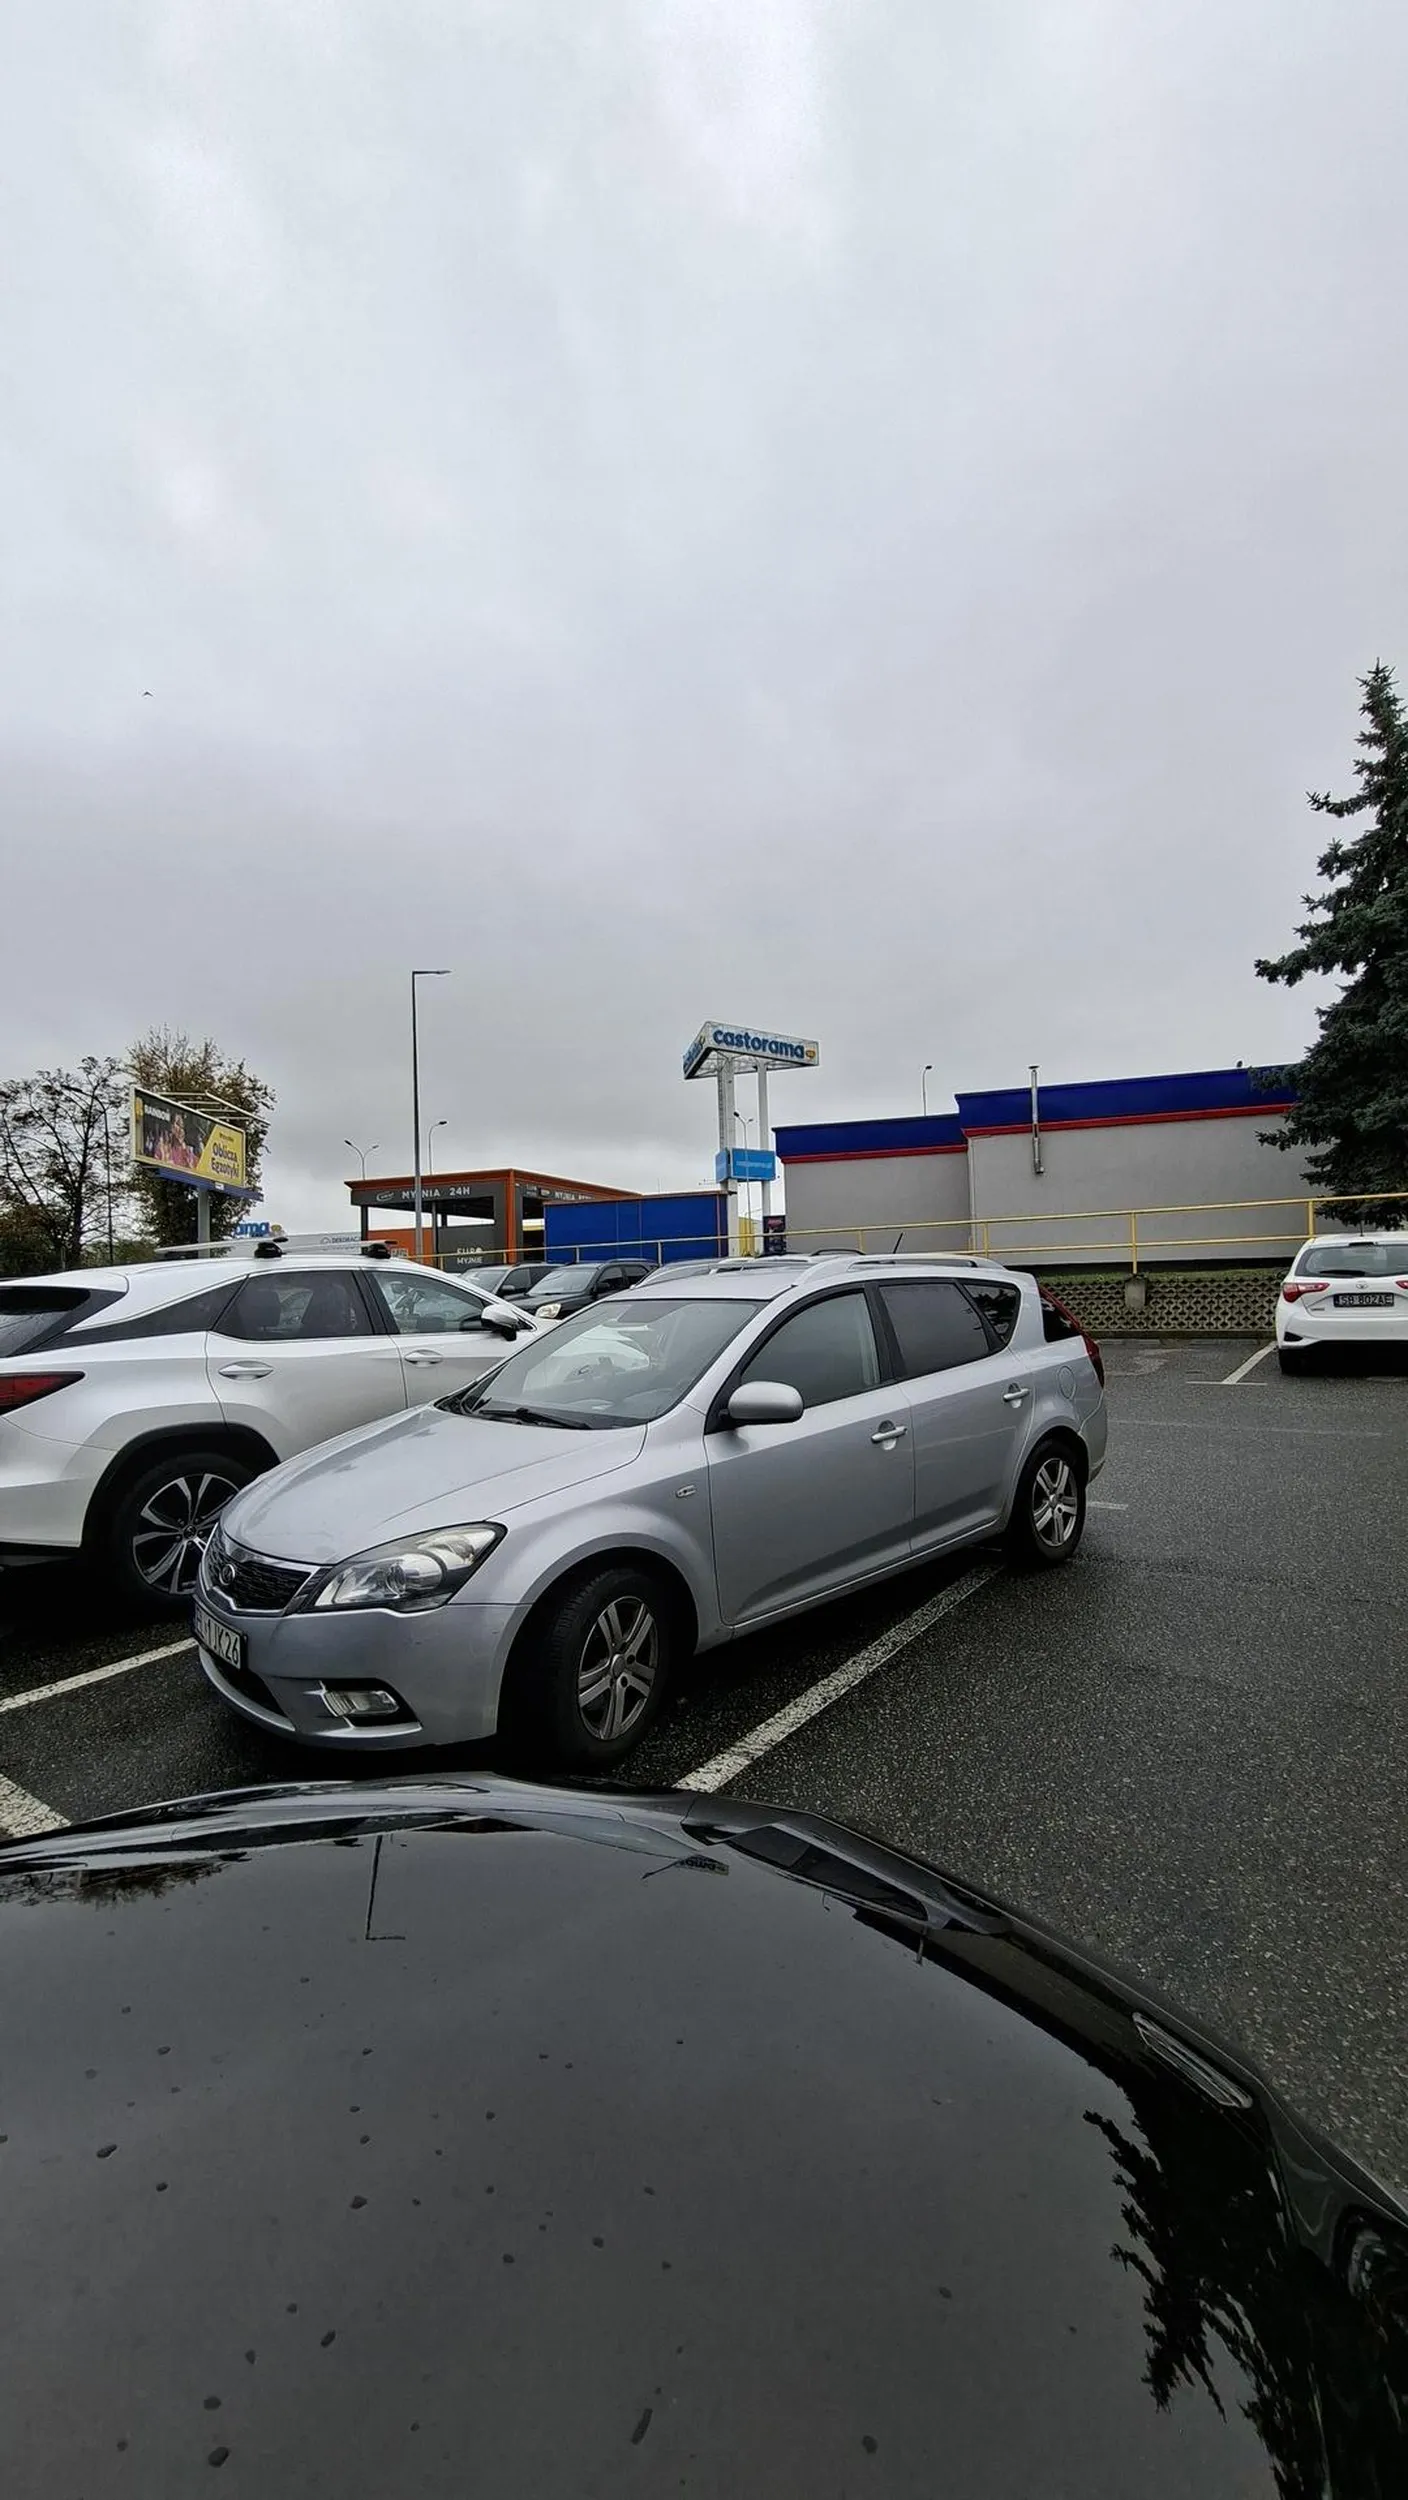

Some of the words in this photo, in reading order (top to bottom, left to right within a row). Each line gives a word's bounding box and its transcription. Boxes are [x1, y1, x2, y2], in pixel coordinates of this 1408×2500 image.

[713, 1029, 805, 1059] castorama
[402, 1188, 441, 1200] MYNIA
[449, 1186, 470, 1196] 24H
